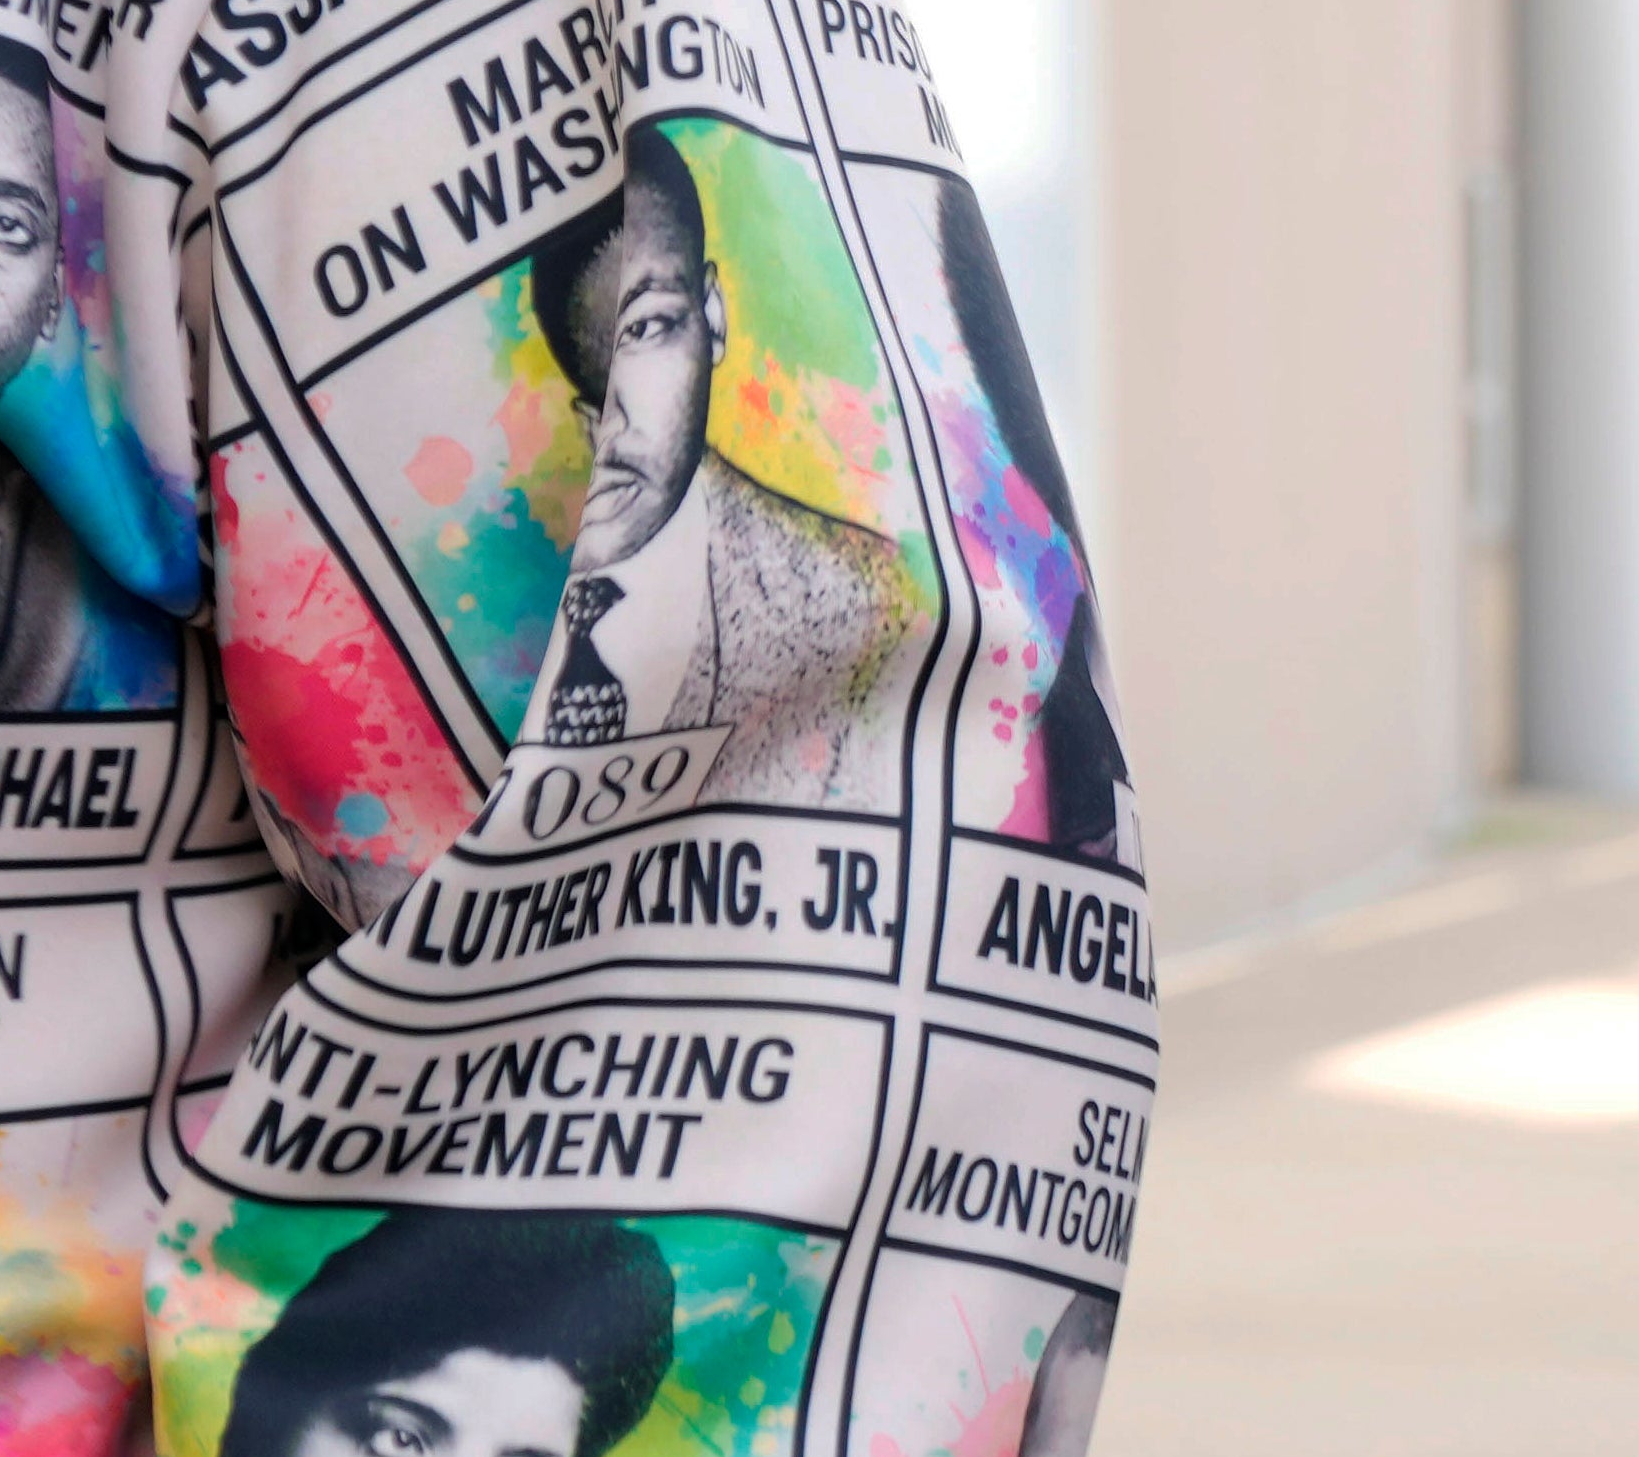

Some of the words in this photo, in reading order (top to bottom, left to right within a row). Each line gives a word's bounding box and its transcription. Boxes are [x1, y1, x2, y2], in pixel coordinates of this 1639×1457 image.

[312, 199, 425, 321] ON
[406, 861, 615, 969] LUTHER
[614, 838, 781, 935] KING,
[801, 847, 902, 941] JR.
[238, 1099, 705, 1181] MOVEMENT
